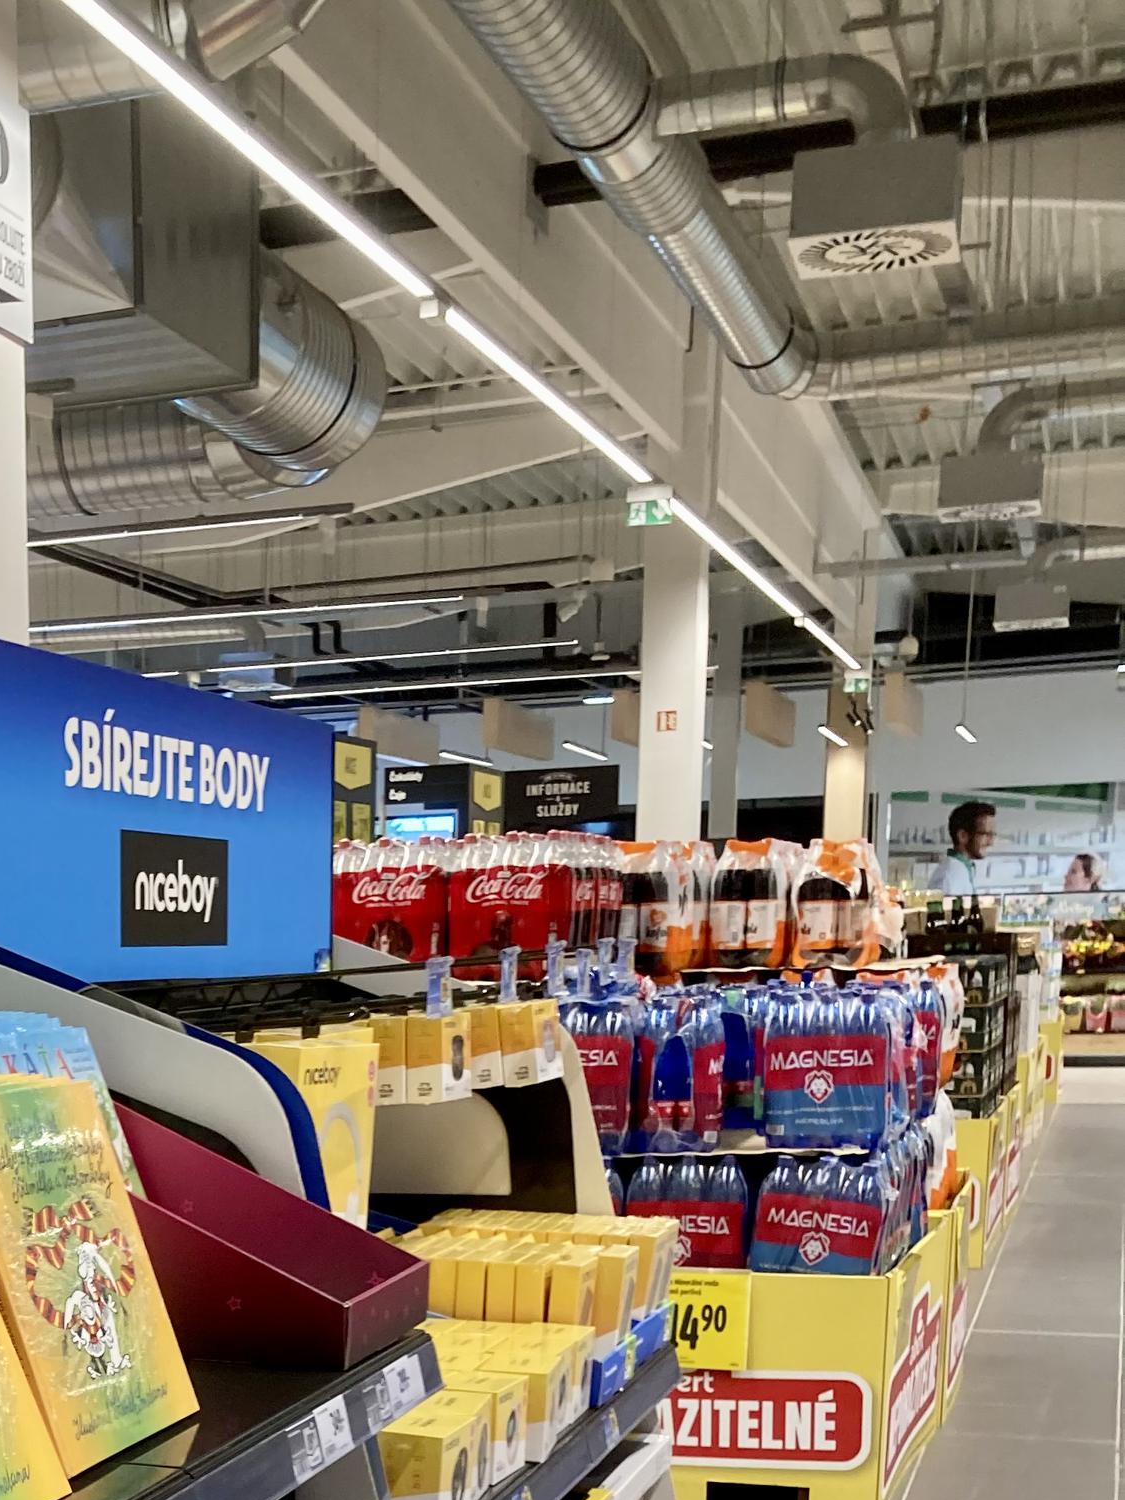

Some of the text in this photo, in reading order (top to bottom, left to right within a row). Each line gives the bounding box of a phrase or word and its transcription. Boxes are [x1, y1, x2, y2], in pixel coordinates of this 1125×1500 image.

[63, 707, 271, 813] SBÍREJTE BODY
[526, 780, 591, 797] INFORMACE
[536, 801, 580, 818] SLUŽBY
[352, 866, 442, 904] Coca-Cola
[465, 868, 549, 903] Coca-Cola
[579, 1049, 619, 1067] ESIA
[770, 1049, 874, 1071] MAGNESIA
[303, 1060, 341, 1087] niceboy
[675, 1214, 730, 1236] NESIA
[767, 1206, 870, 1238] MAGNESIA
[676, 1372, 715, 1394] ert
[655, 1389, 837, 1451] AZITELNÉ
